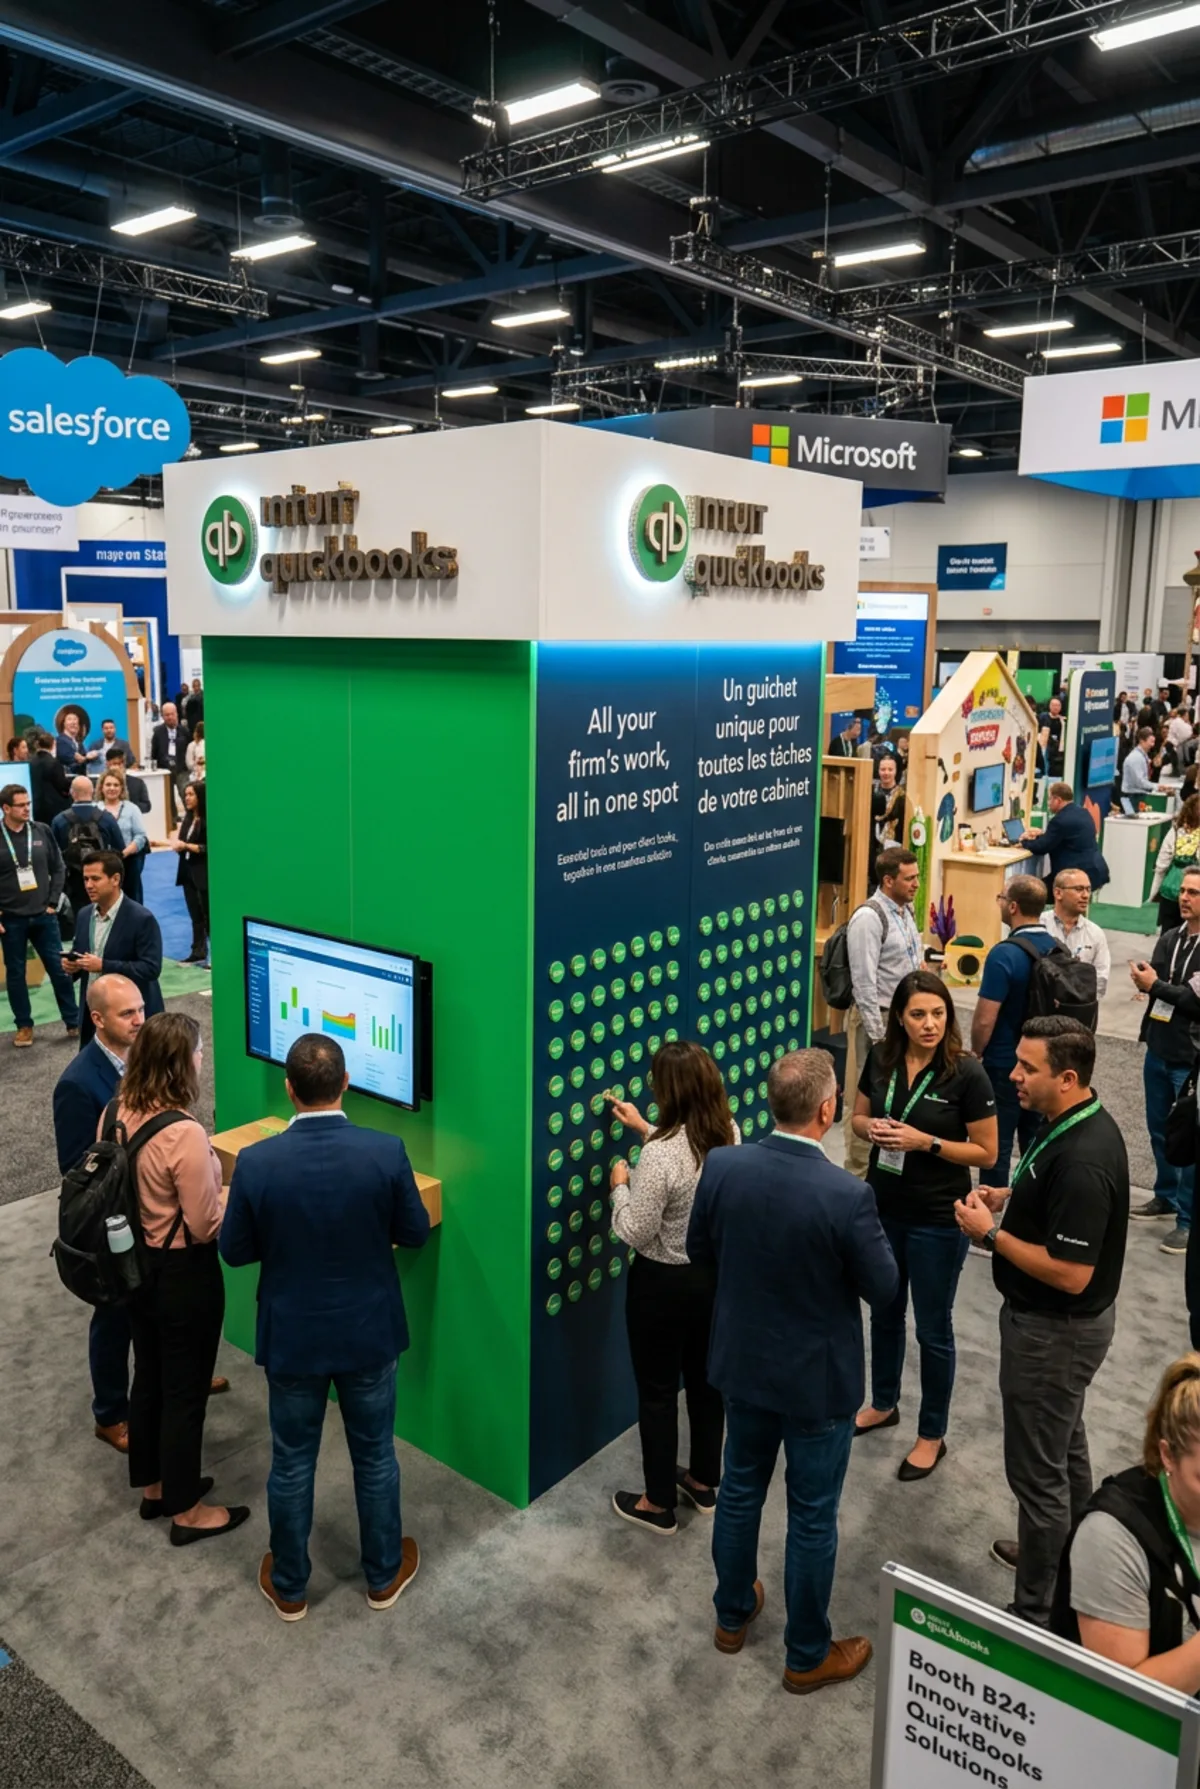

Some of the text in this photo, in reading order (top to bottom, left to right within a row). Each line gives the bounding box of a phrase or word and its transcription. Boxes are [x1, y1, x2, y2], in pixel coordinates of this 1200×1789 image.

[8, 403, 171, 446] salesforce
[1161, 398, 1200, 431] M
[797, 435, 917, 471] Microsoft
[723, 675, 798, 706] Un guichet
[587, 706, 657, 739] All your
[715, 714, 800, 742] unique pour
[568, 741, 671, 778] firm's work,
[697, 754, 744, 778] toutes
[747, 747, 767, 771] les
[556, 781, 679, 822] all in one spot
[698, 777, 810, 814] de votre cabinet
[909, 1649, 1036, 1725] Booth B24:
[907, 1673, 1027, 1747] Innovative
[904, 1724, 1009, 1789] Solutions
[906, 1700, 1043, 1781] QuickBooks
